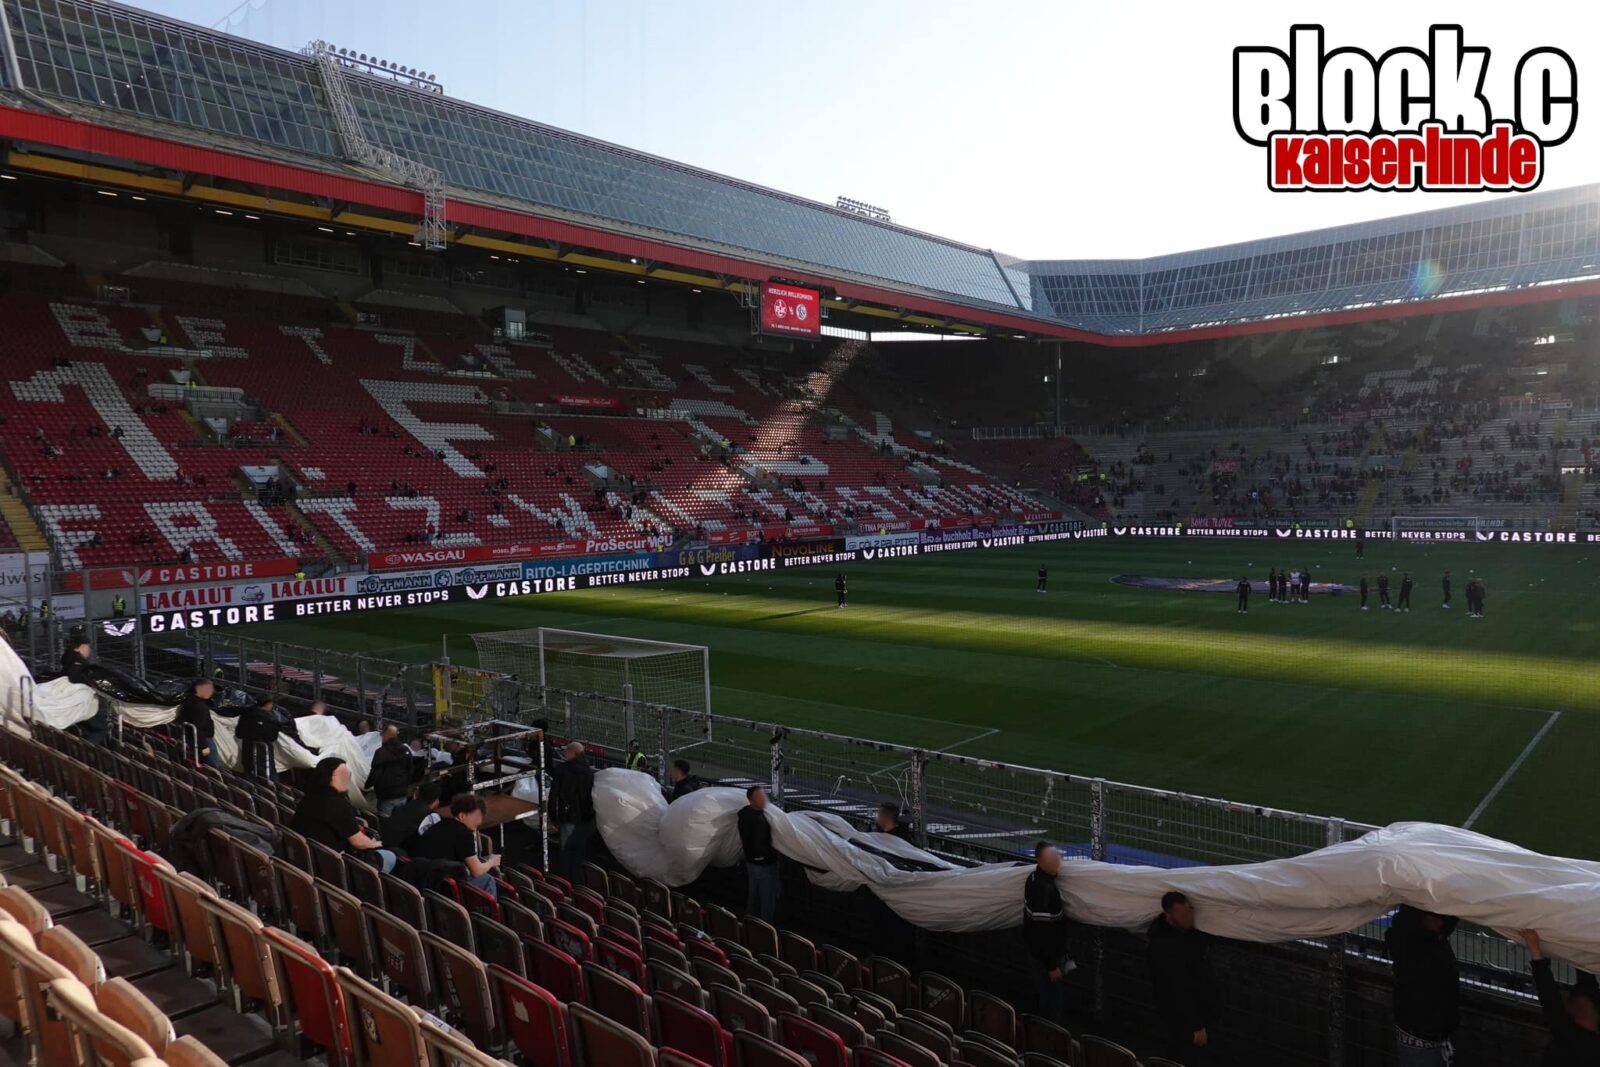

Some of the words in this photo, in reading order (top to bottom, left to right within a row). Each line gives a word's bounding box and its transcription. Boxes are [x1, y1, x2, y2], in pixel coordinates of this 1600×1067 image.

[1050, 521, 1082, 532] CASTORE
[1083, 528, 1108, 538] CASTORE
[1130, 527, 1181, 536] CASTORE
[1187, 528, 1214, 536] BETTER
[1217, 528, 1240, 536] NEVER
[1243, 529, 1268, 537] STOPS
[1296, 529, 1357, 539] CASTORE
[993, 535, 1025, 547] CASTORE
[1435, 531, 1466, 539] STOPS
[1500, 532, 1576, 542] CASTORE
[586, 538, 646, 552] ProSecur
[877, 545, 918, 558] CASTORE
[924, 542, 943, 553] BETTER
[944, 541, 960, 551] NEVER
[962, 540, 977, 549] STOPS
[400, 550, 465, 562] WASGAU
[679, 551, 687, 565] G
[688, 551, 695, 565] &
[697, 550, 704, 564] G
[784, 554, 810, 567] BETTER
[812, 553, 834, 564] NEVER
[835, 552, 856, 561] STOPS
[160, 563, 254, 581] CASTORE
[526, 558, 650, 579] BITO-LAGERTECHNIK
[720, 558, 776, 574] CASTORE
[455, 567, 520, 585] HOFFMANN
[589, 573, 625, 586] BETTER
[629, 571, 658, 582] NEVER
[662, 568, 689, 579] STOPS
[271, 578, 346, 598] LACALUT
[357, 575, 433, 593] HOFFMANN
[496, 577, 576, 597] CASTORE
[146, 587, 234, 609] LACALUT
[296, 599, 351, 616] BETTER
[357, 594, 402, 610] NEVER
[407, 590, 449, 604] STOPS
[150, 604, 275, 632] CASTORE
